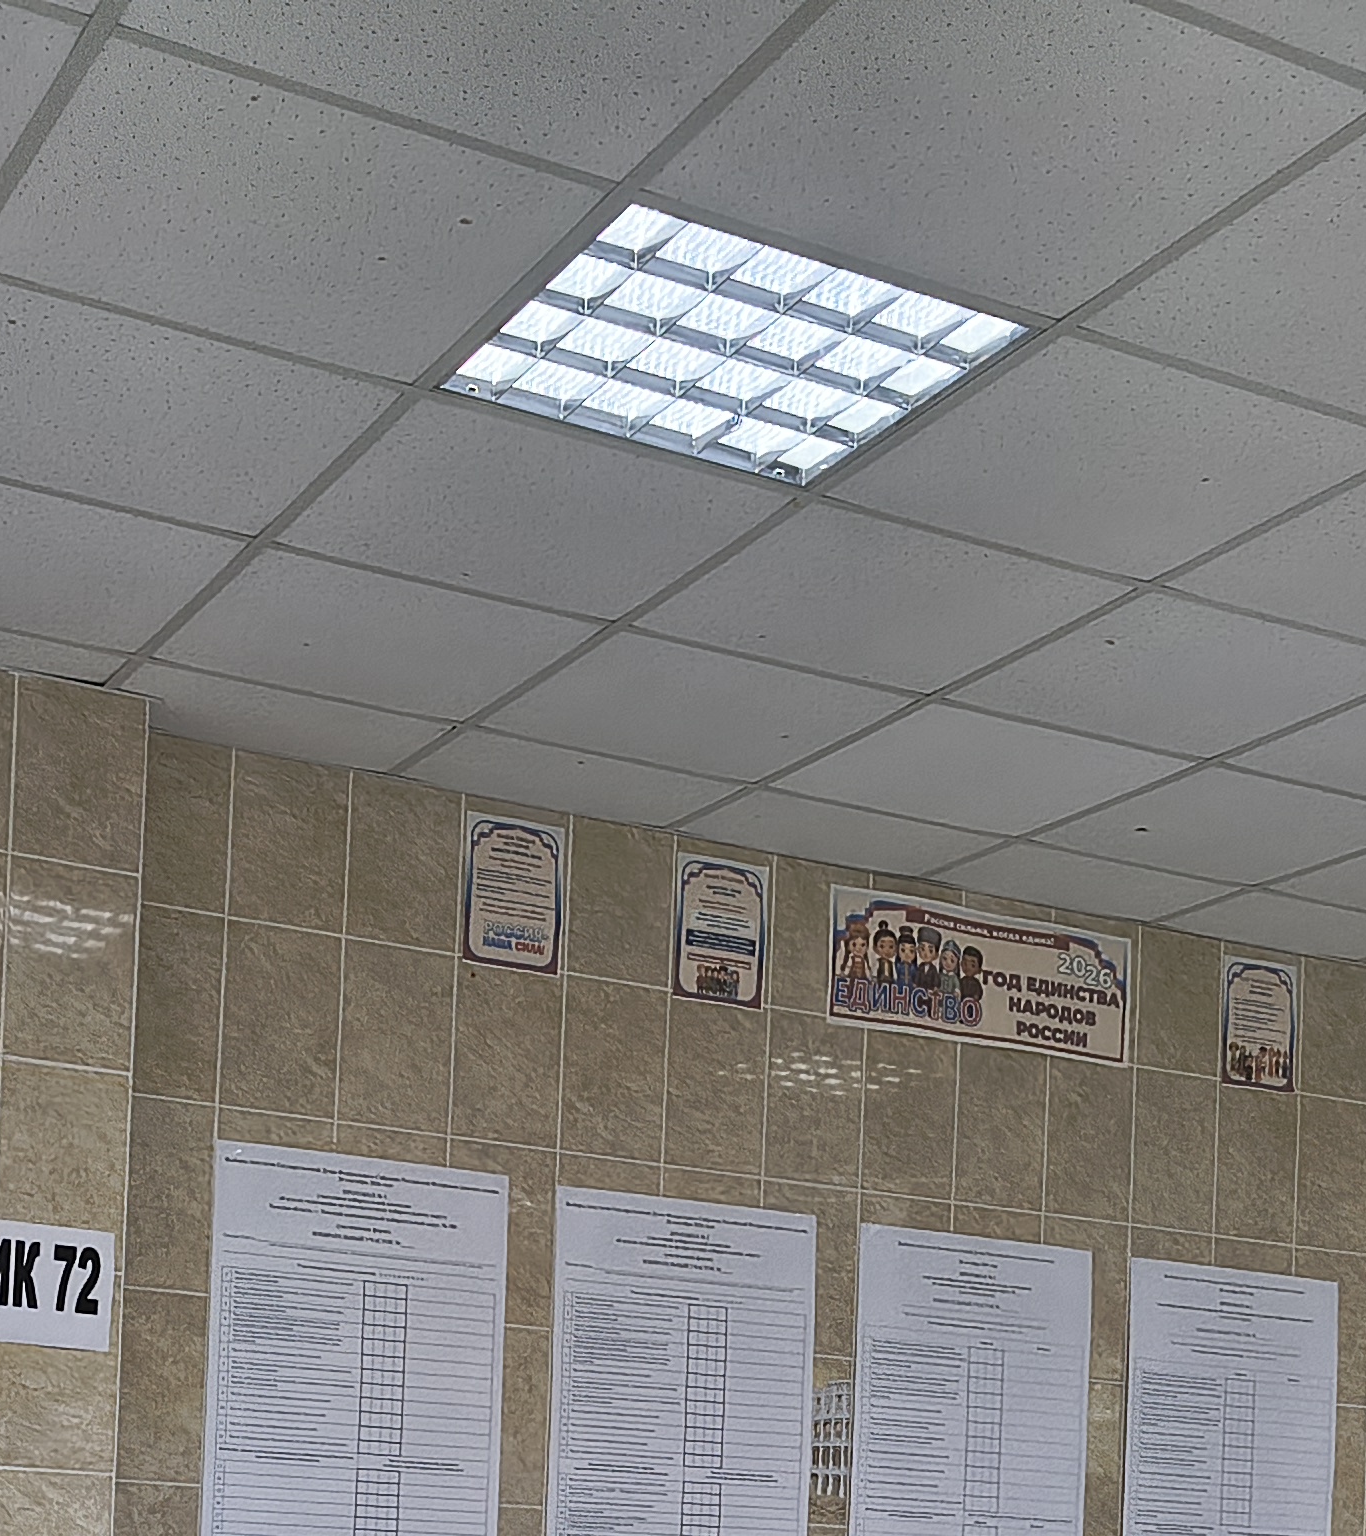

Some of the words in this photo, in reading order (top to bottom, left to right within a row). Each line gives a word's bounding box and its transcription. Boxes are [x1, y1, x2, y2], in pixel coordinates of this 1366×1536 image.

[1057, 951, 1114, 989] 2026
[834, 977, 983, 1027] ЕДИНСТВО
[982, 970, 1022, 993] ГОД
[1026, 976, 1121, 1009] ЕДИНСТВА
[1008, 996, 1096, 1027] НАРОДОВ
[1016, 1021, 1088, 1048] РОССИИ
[53, 1244, 101, 1315] 72
